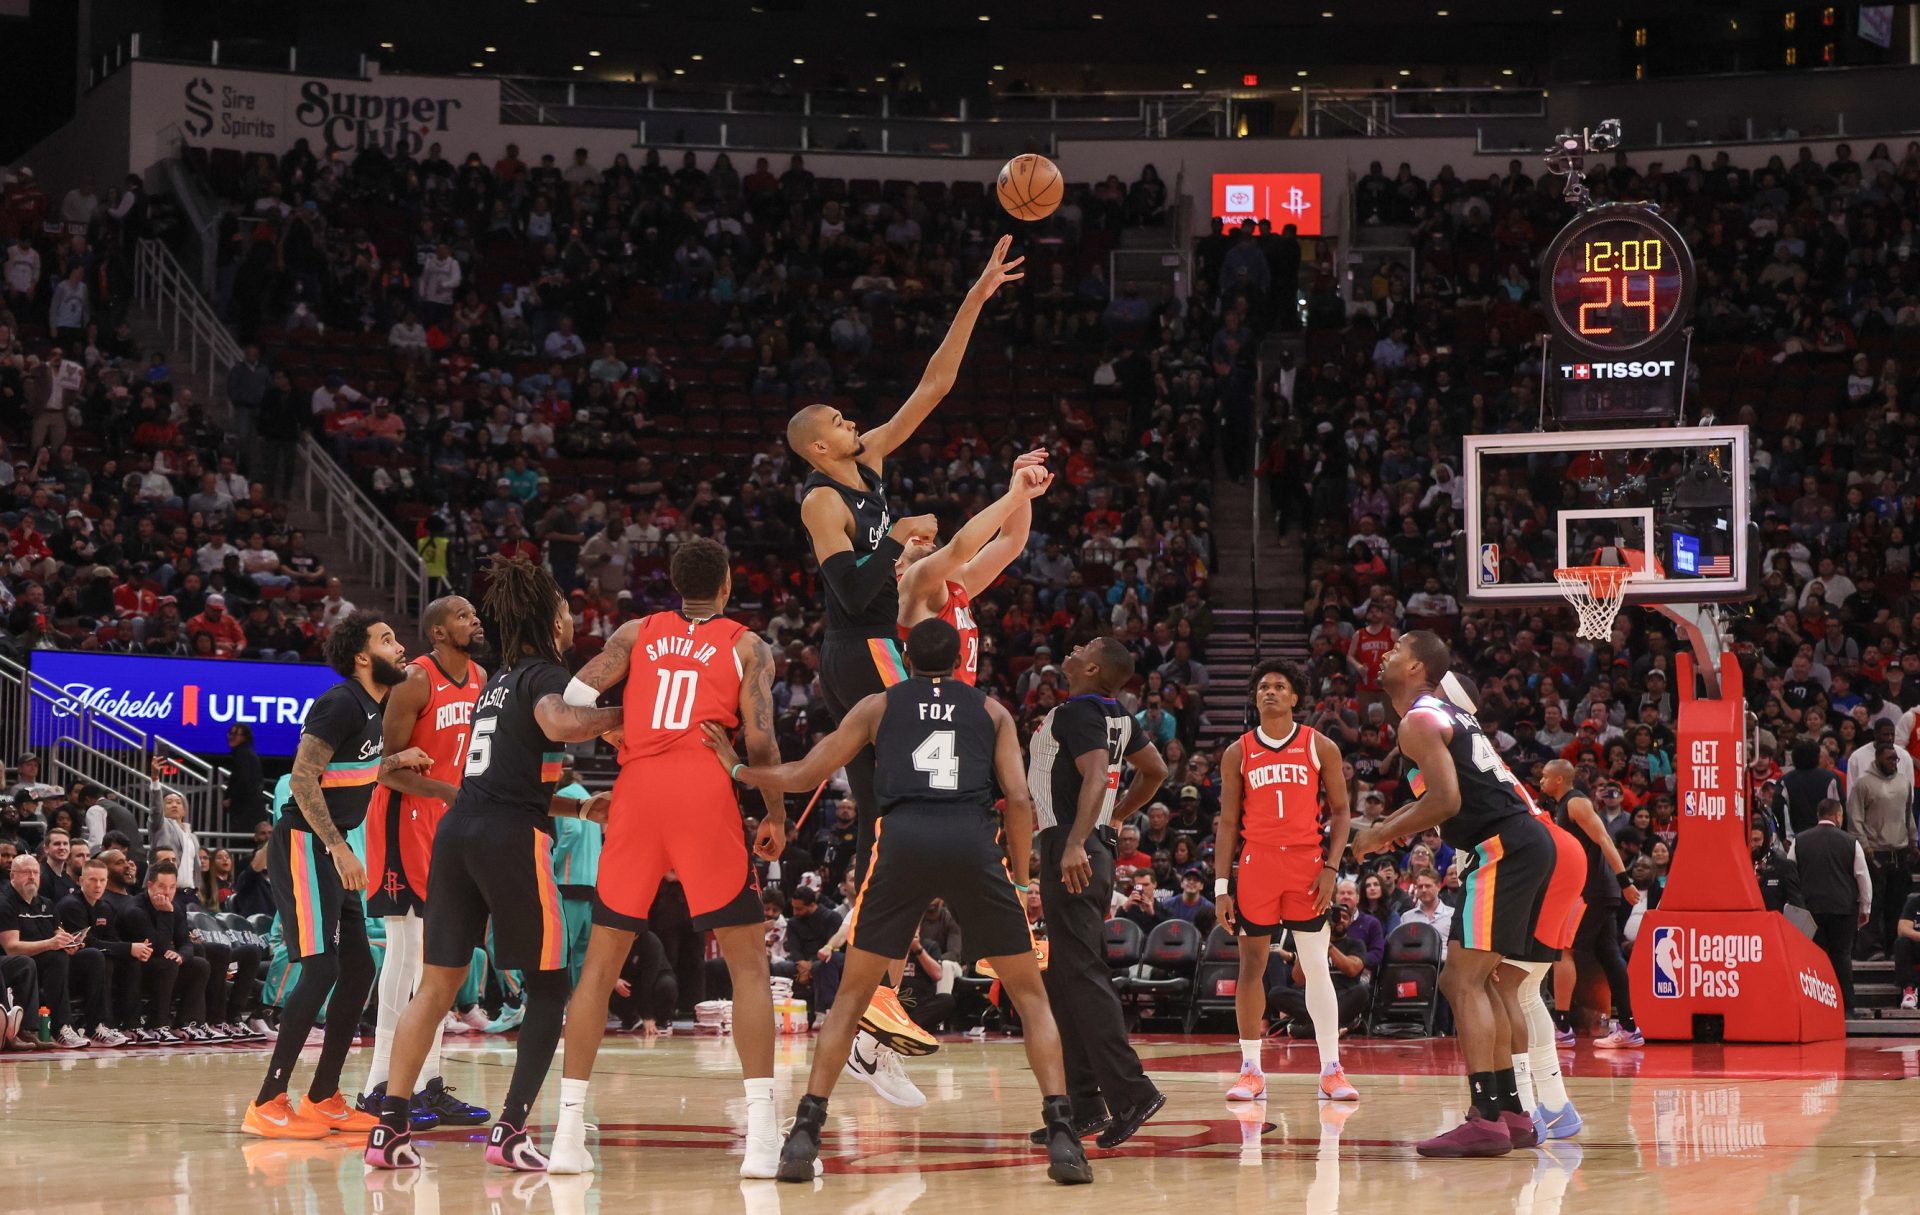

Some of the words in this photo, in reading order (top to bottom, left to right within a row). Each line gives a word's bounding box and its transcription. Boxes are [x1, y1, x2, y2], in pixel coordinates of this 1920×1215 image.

[221, 86, 255, 110] Sire
[296, 81, 462, 131] Supper
[221, 113, 275, 139] Spirits
[323, 115, 423, 156] Club
[1585, 240, 1661, 273] 12:00
[1579, 275, 1655, 335] 24
[1592, 360, 1675, 379] TISSOT
[645, 635, 694, 661] SMITH
[693, 642, 717, 666] JR.
[52, 682, 174, 719] Michelob
[651, 667, 698, 730] 10
[918, 702, 956, 722] FOX
[453, 732, 466, 767] 7
[464, 714, 498, 778] 5
[911, 730, 959, 790] 4
[1691, 740, 1719, 764] GET
[1248, 763, 1308, 790] ROCKETS
[1691, 765, 1719, 789] THE
[1276, 790, 1284, 819] 1
[1698, 791, 1726, 821] App
[1690, 928, 1763, 969] League
[1658, 981, 1673, 994] NBA
[1690, 963, 1740, 998] Pass
[1799, 967, 1838, 1009] coinbase
